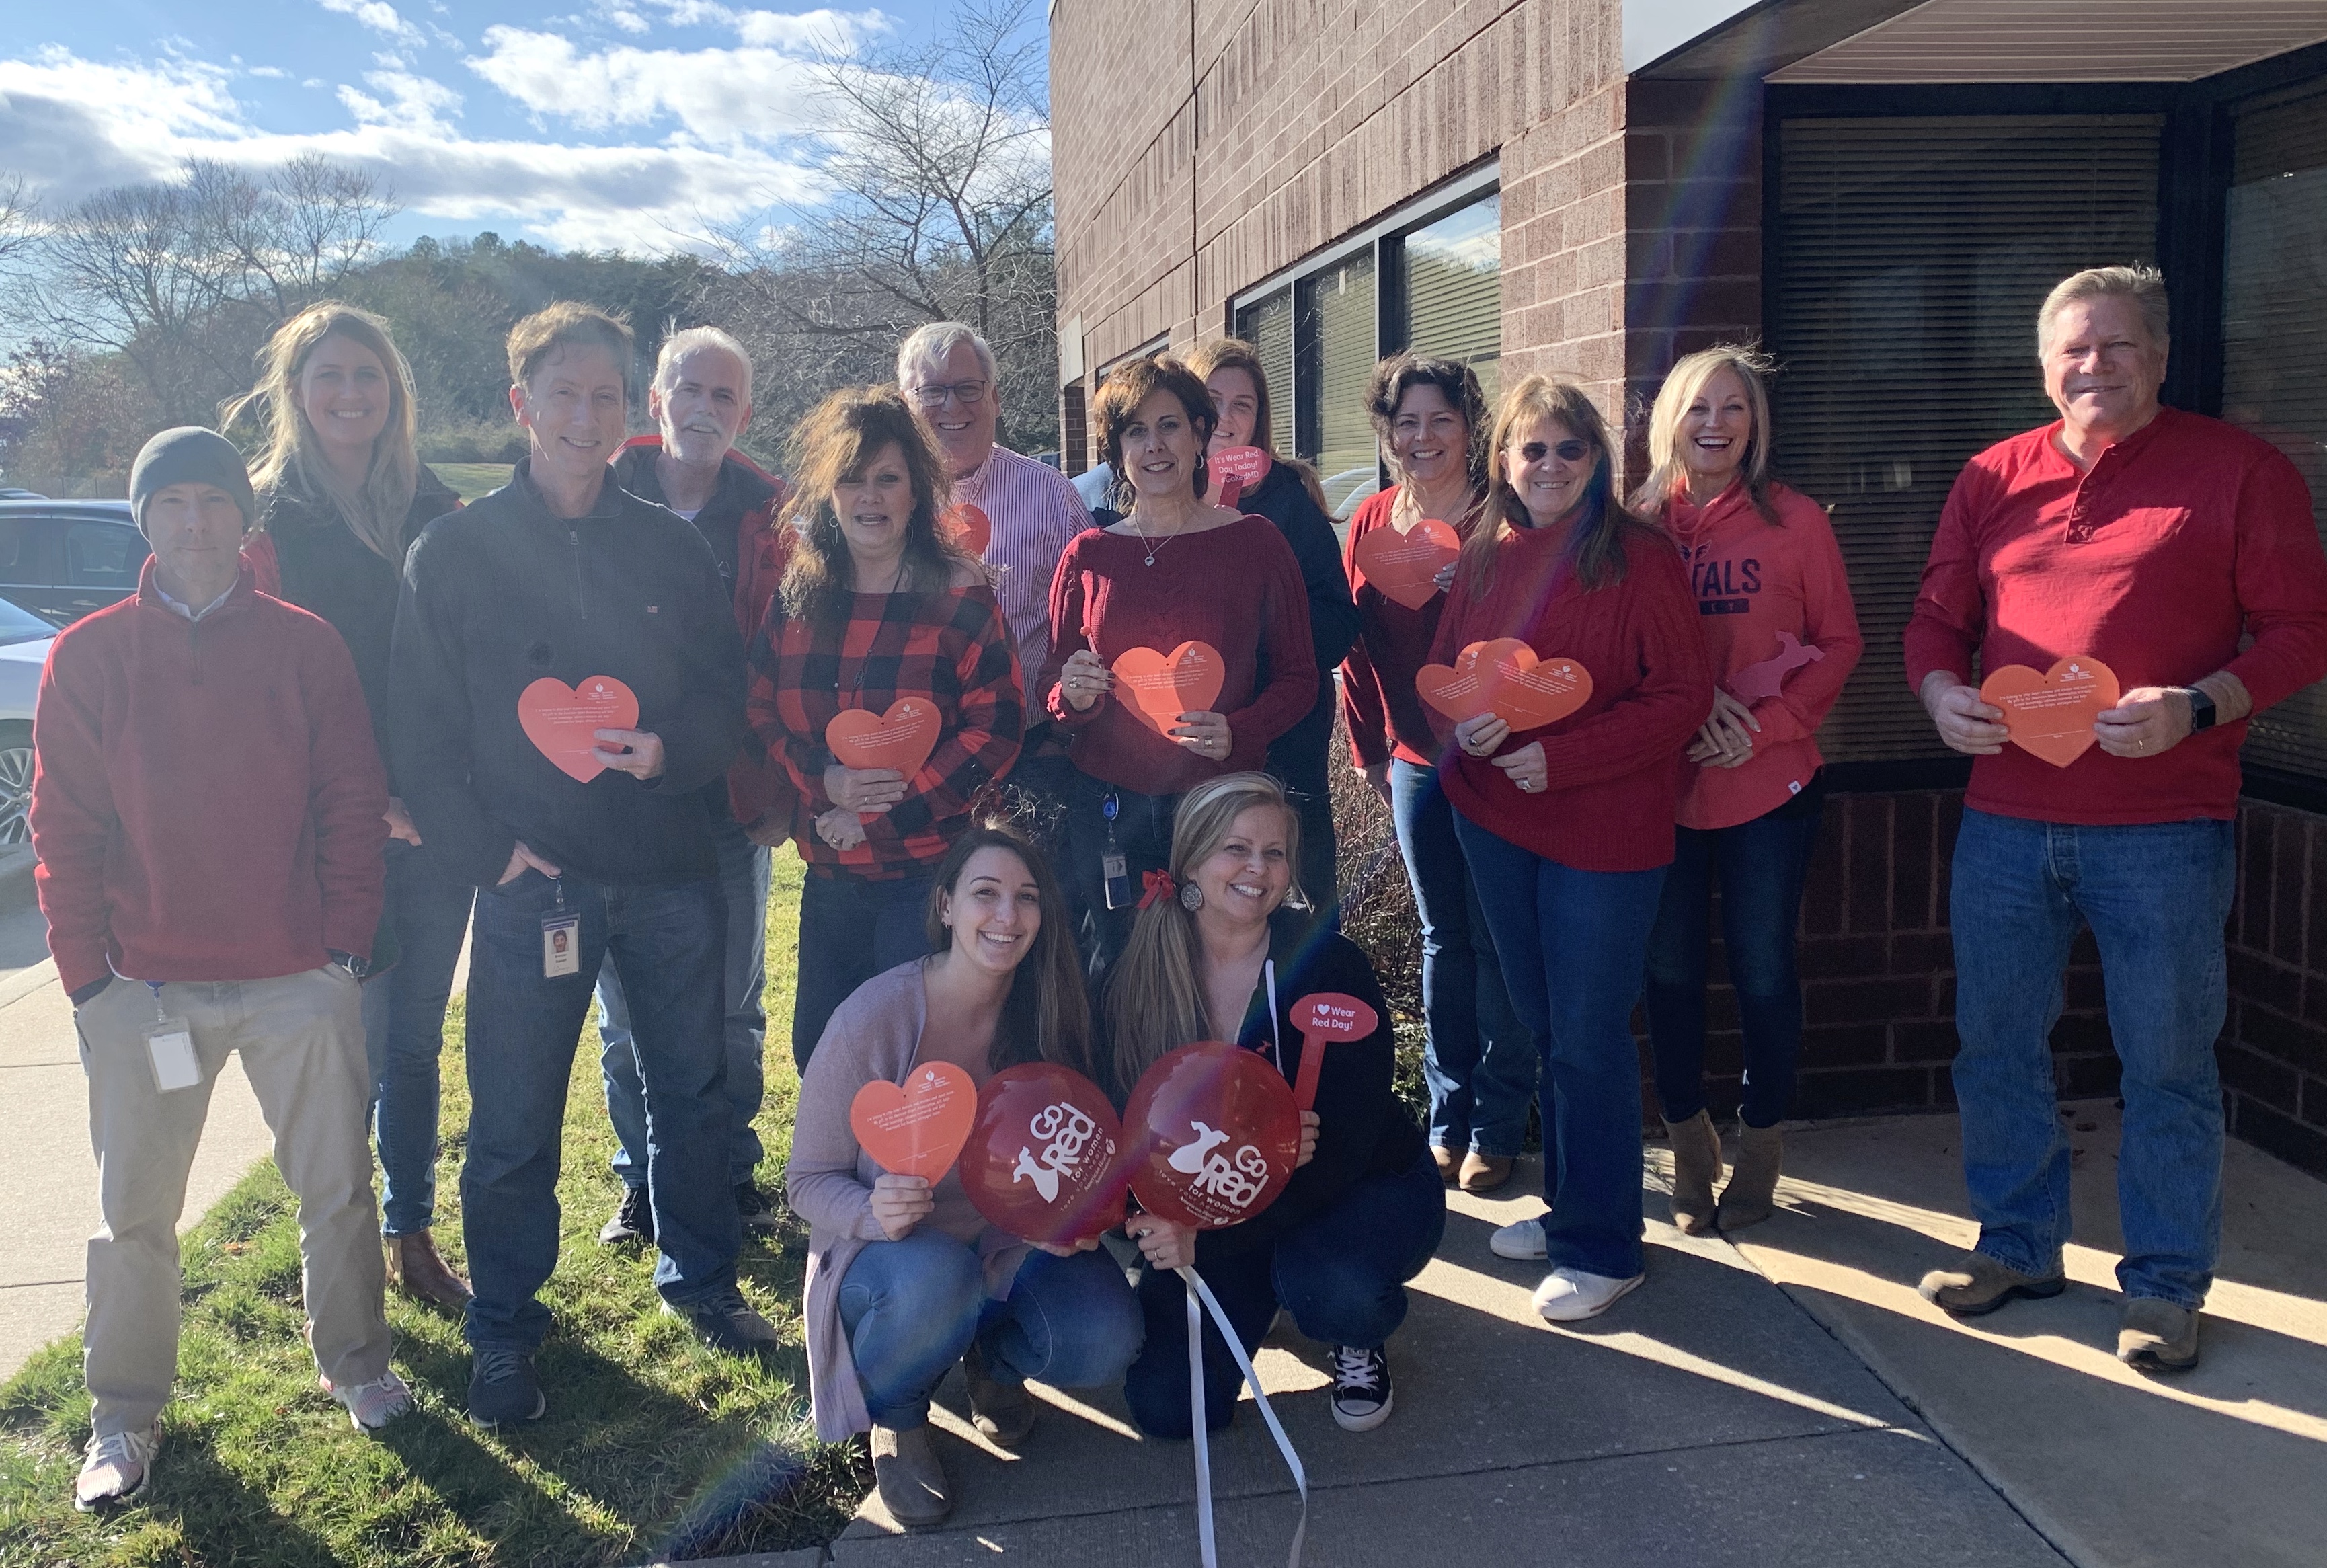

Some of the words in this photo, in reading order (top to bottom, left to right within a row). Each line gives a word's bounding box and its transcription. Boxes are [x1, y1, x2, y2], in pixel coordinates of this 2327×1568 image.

[1214, 457, 1225, 465] It's
[1226, 454, 1244, 462] Wear
[1245, 450, 1259, 459] Red
[1234, 461, 1257, 471] Today!
[1221, 471, 1259, 483] #GoRedMD
[1312, 1005, 1316, 1014] I
[1331, 1007, 1356, 1017] Wear
[1312, 1017, 1329, 1027] Red
[1331, 1019, 1353, 1032] Day!
[1030, 1105, 1063, 1140] Go
[1041, 1102, 1096, 1177] Red
[1071, 1167, 1084, 1182] for
[1082, 1127, 1104, 1165] women
[1236, 1145, 1267, 1177] Go
[1193, 1153, 1269, 1208] Red
[1189, 1185, 1204, 1198] for
[1207, 1197, 1241, 1214] women
